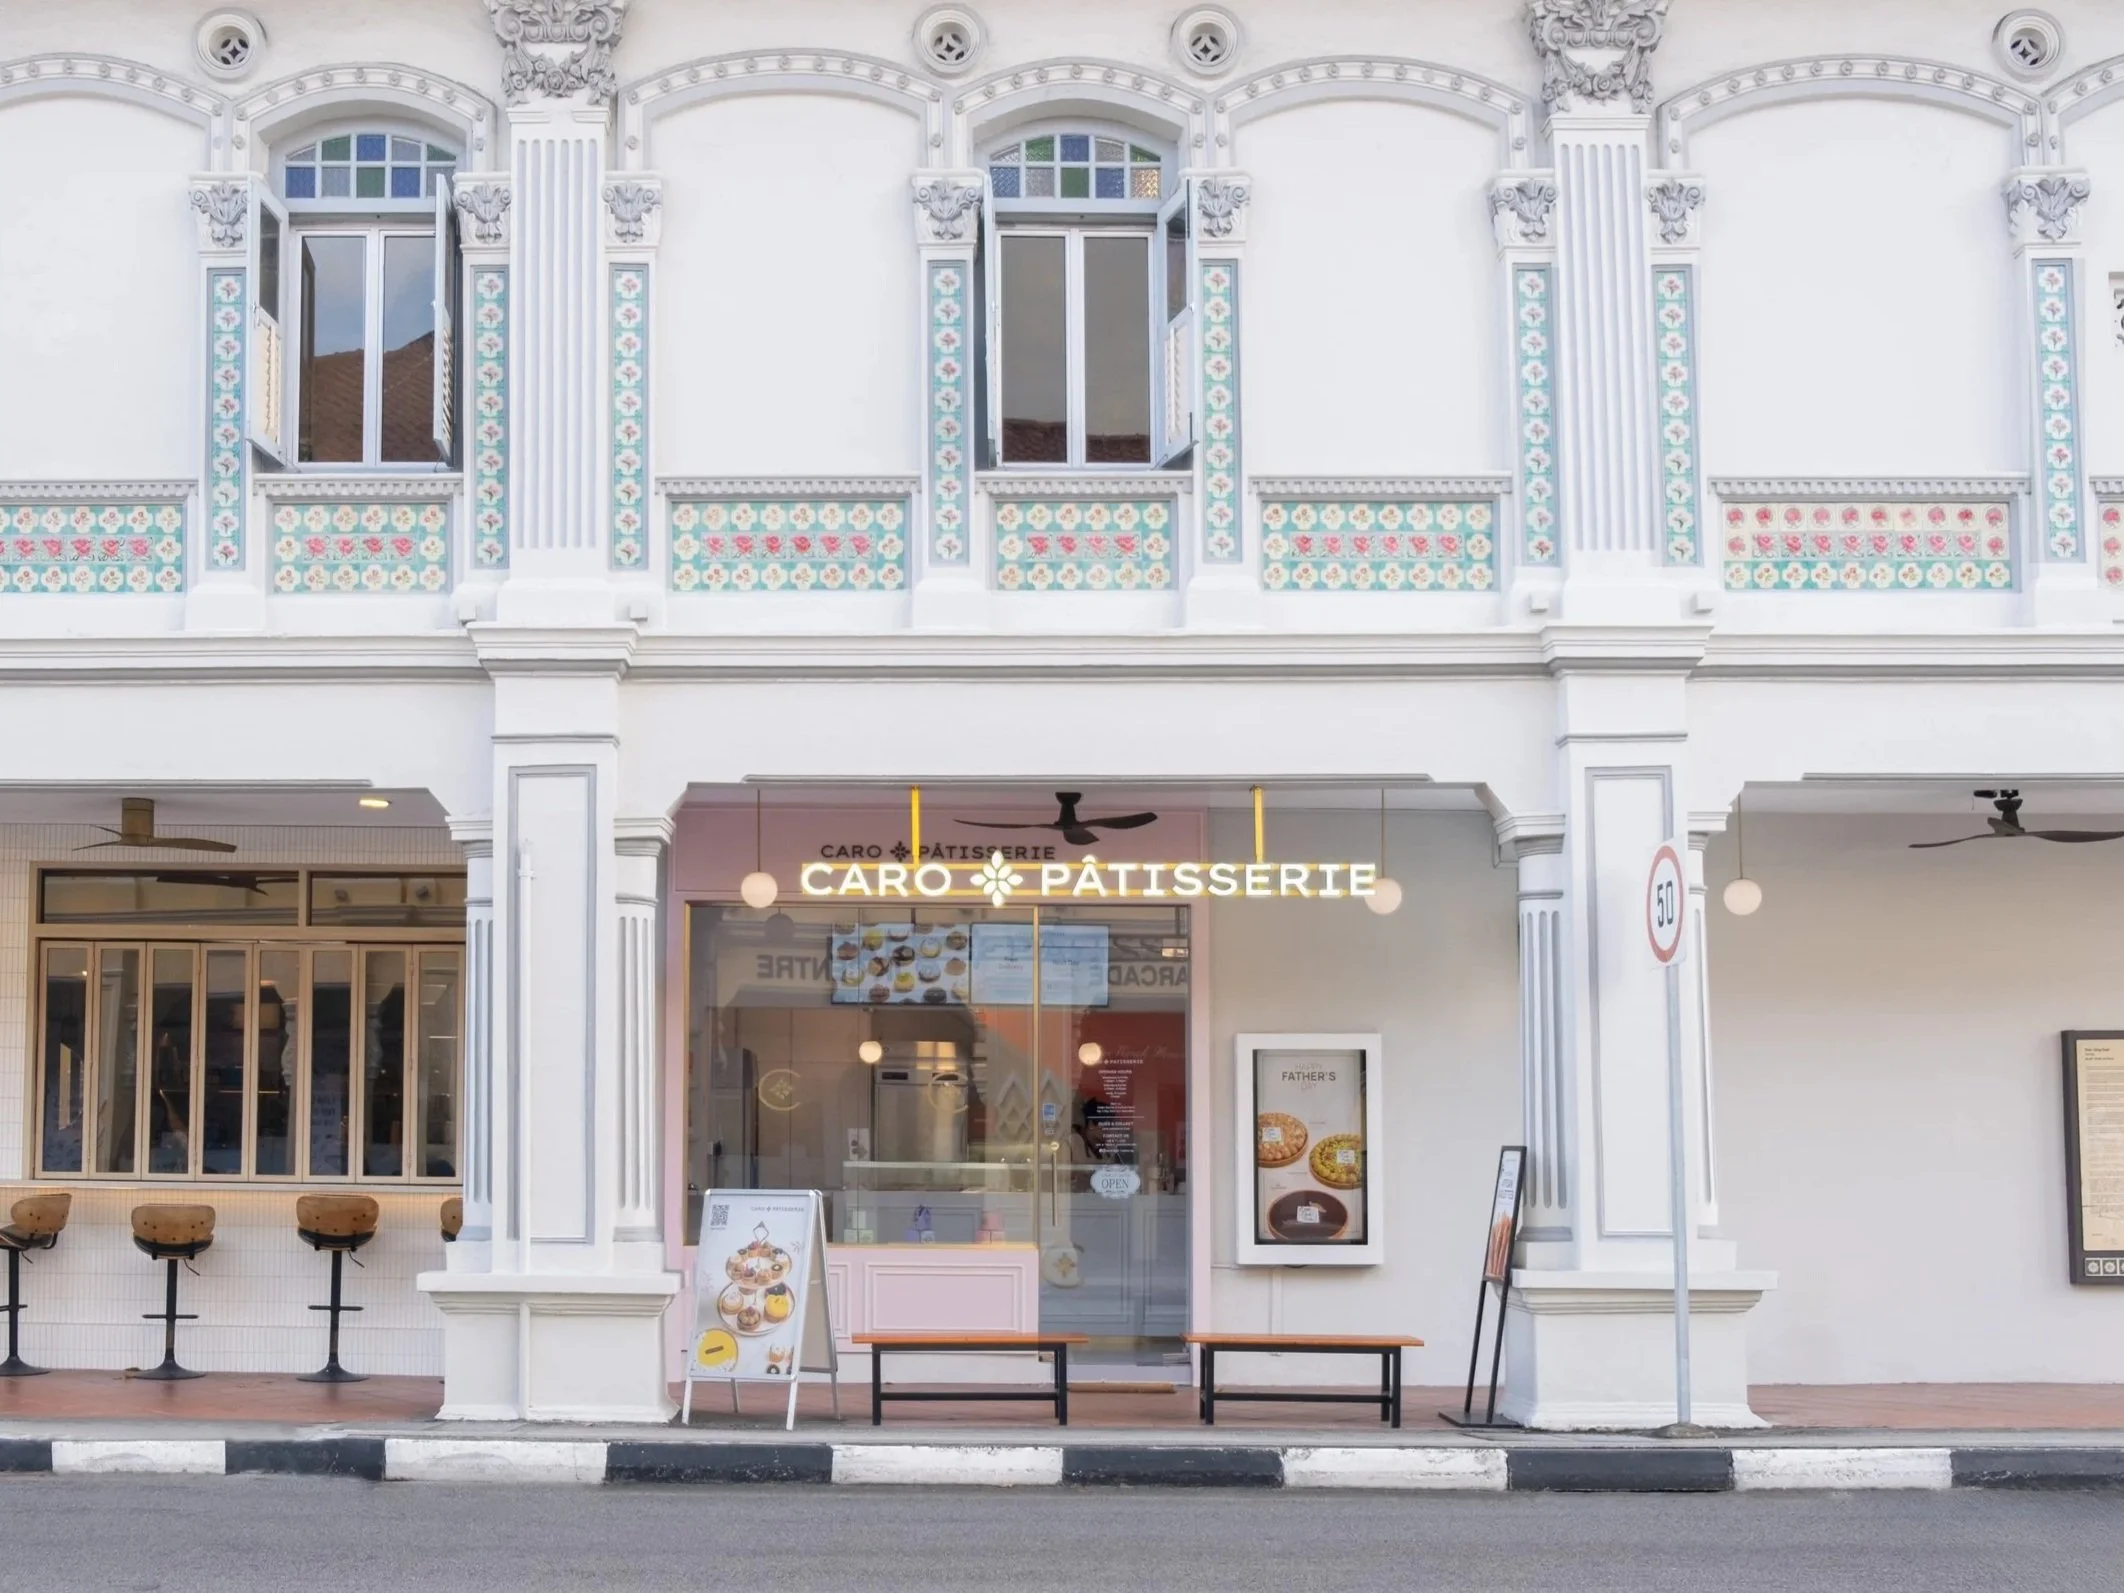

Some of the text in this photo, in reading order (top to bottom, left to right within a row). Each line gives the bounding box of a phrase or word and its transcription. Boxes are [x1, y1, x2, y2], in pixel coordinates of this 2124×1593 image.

[820, 844, 882, 858] CARO
[801, 855, 1376, 897] CARO PÂTISSERIE
[1657, 880, 1674, 928] 50
[1281, 1071, 1337, 1082] FATHER'S
[1101, 1178, 1129, 1189] OPEN
